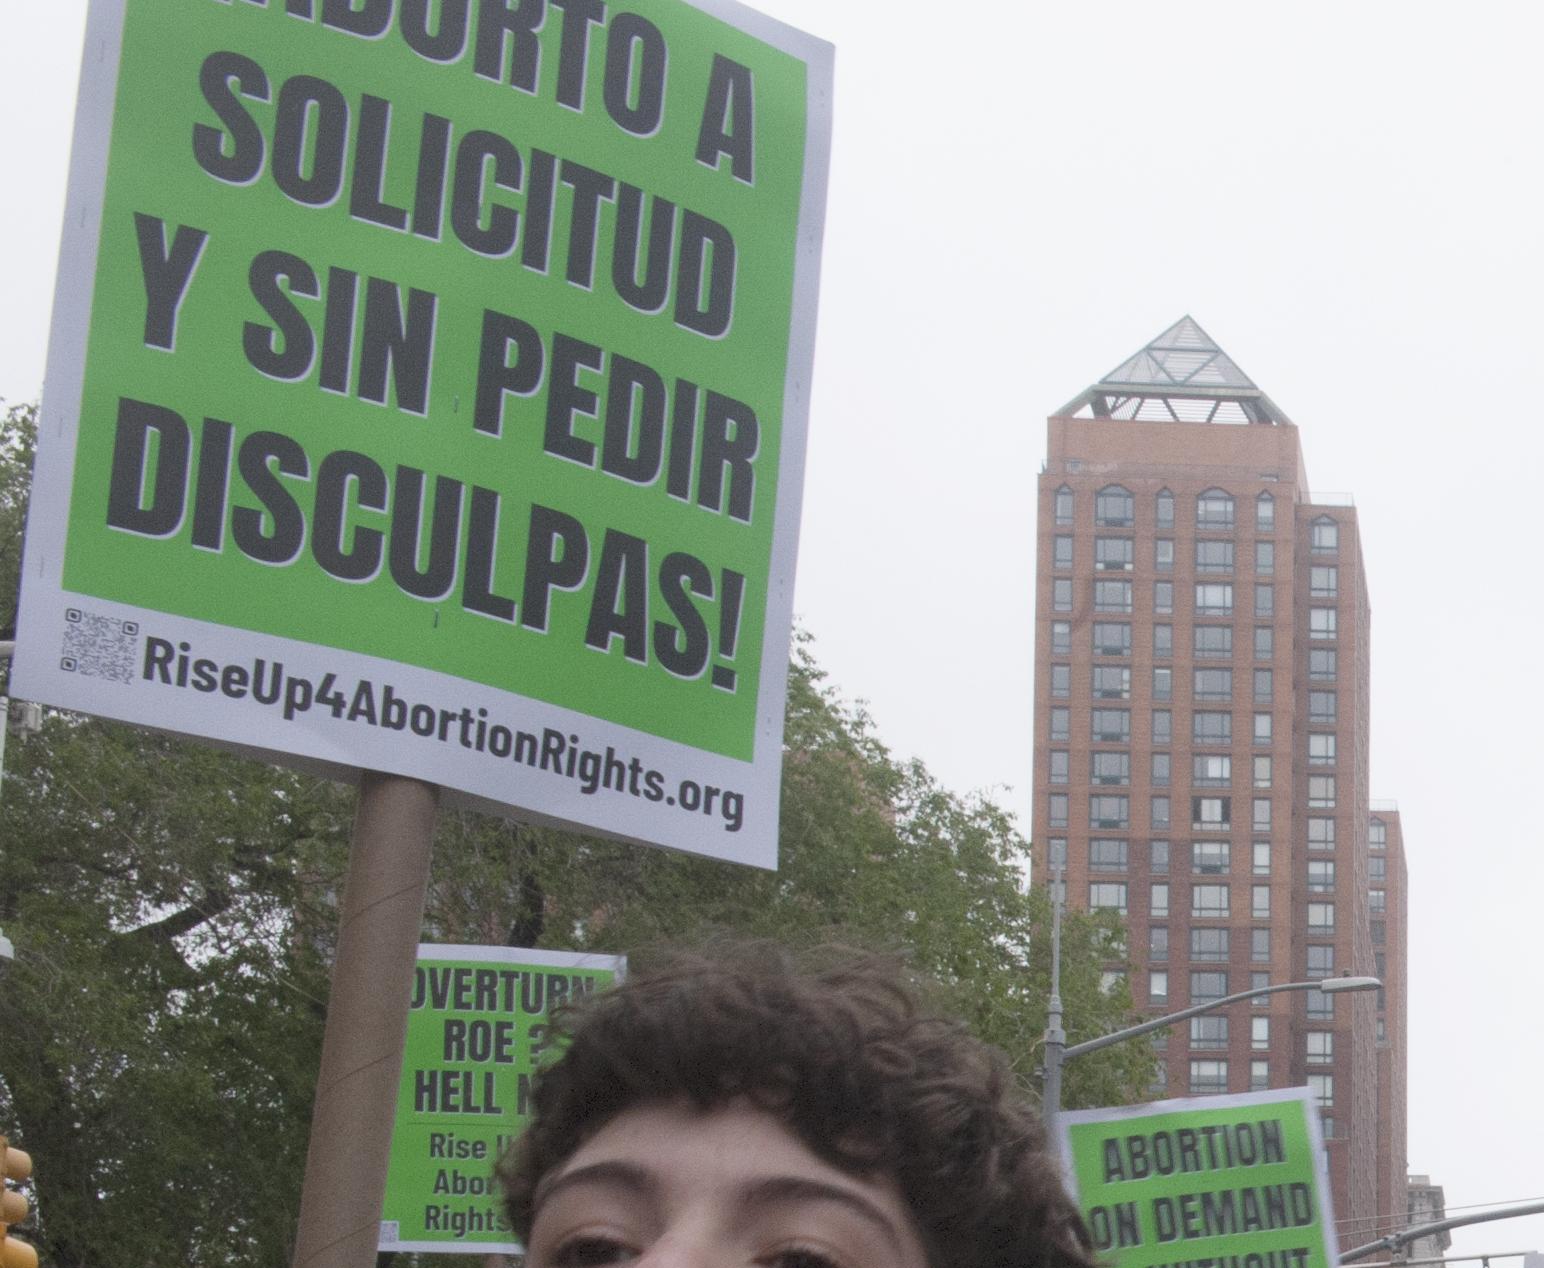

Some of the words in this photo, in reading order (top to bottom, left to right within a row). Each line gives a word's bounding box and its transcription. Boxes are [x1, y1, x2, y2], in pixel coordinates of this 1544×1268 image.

[206, 0, 670, 138] ORTO
[694, 52, 756, 188] A
[191, 51, 738, 341] SOLICITUD
[132, 212, 208, 352] Y
[241, 250, 438, 418] SIN
[472, 308, 760, 523] PEDIR
[105, 396, 746, 692] DISCULPAS!
[142, 635, 745, 831] RiseUp4AbortionRights.org
[414, 1070, 504, 1115] HELL
[443, 1019, 515, 1064] ROE
[430, 1133, 487, 1159] Rise
[1102, 1119, 1287, 1184] ABORTION
[1089, 1201, 1143, 1250] ON
[1151, 1181, 1316, 1243] DEMAND
